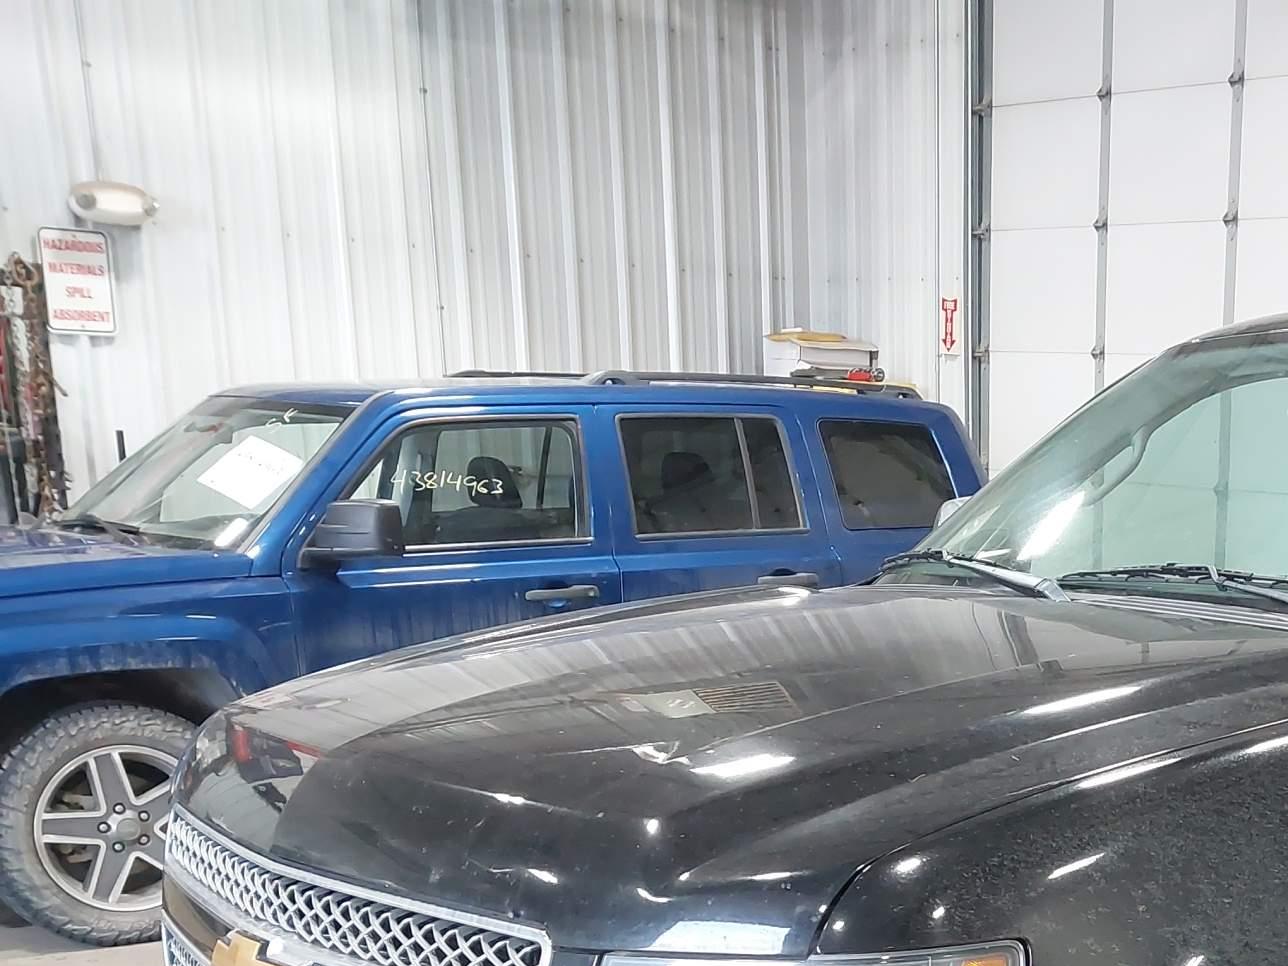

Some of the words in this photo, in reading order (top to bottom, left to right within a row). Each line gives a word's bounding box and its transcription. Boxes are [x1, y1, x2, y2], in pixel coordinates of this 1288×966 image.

[43, 238, 105, 254] HAZARDOUS
[47, 262, 105, 277] MATERIALS
[65, 285, 94, 299] SPILL
[53, 310, 110, 322] ABSORBENT
[390, 469, 504, 497] 43814963
